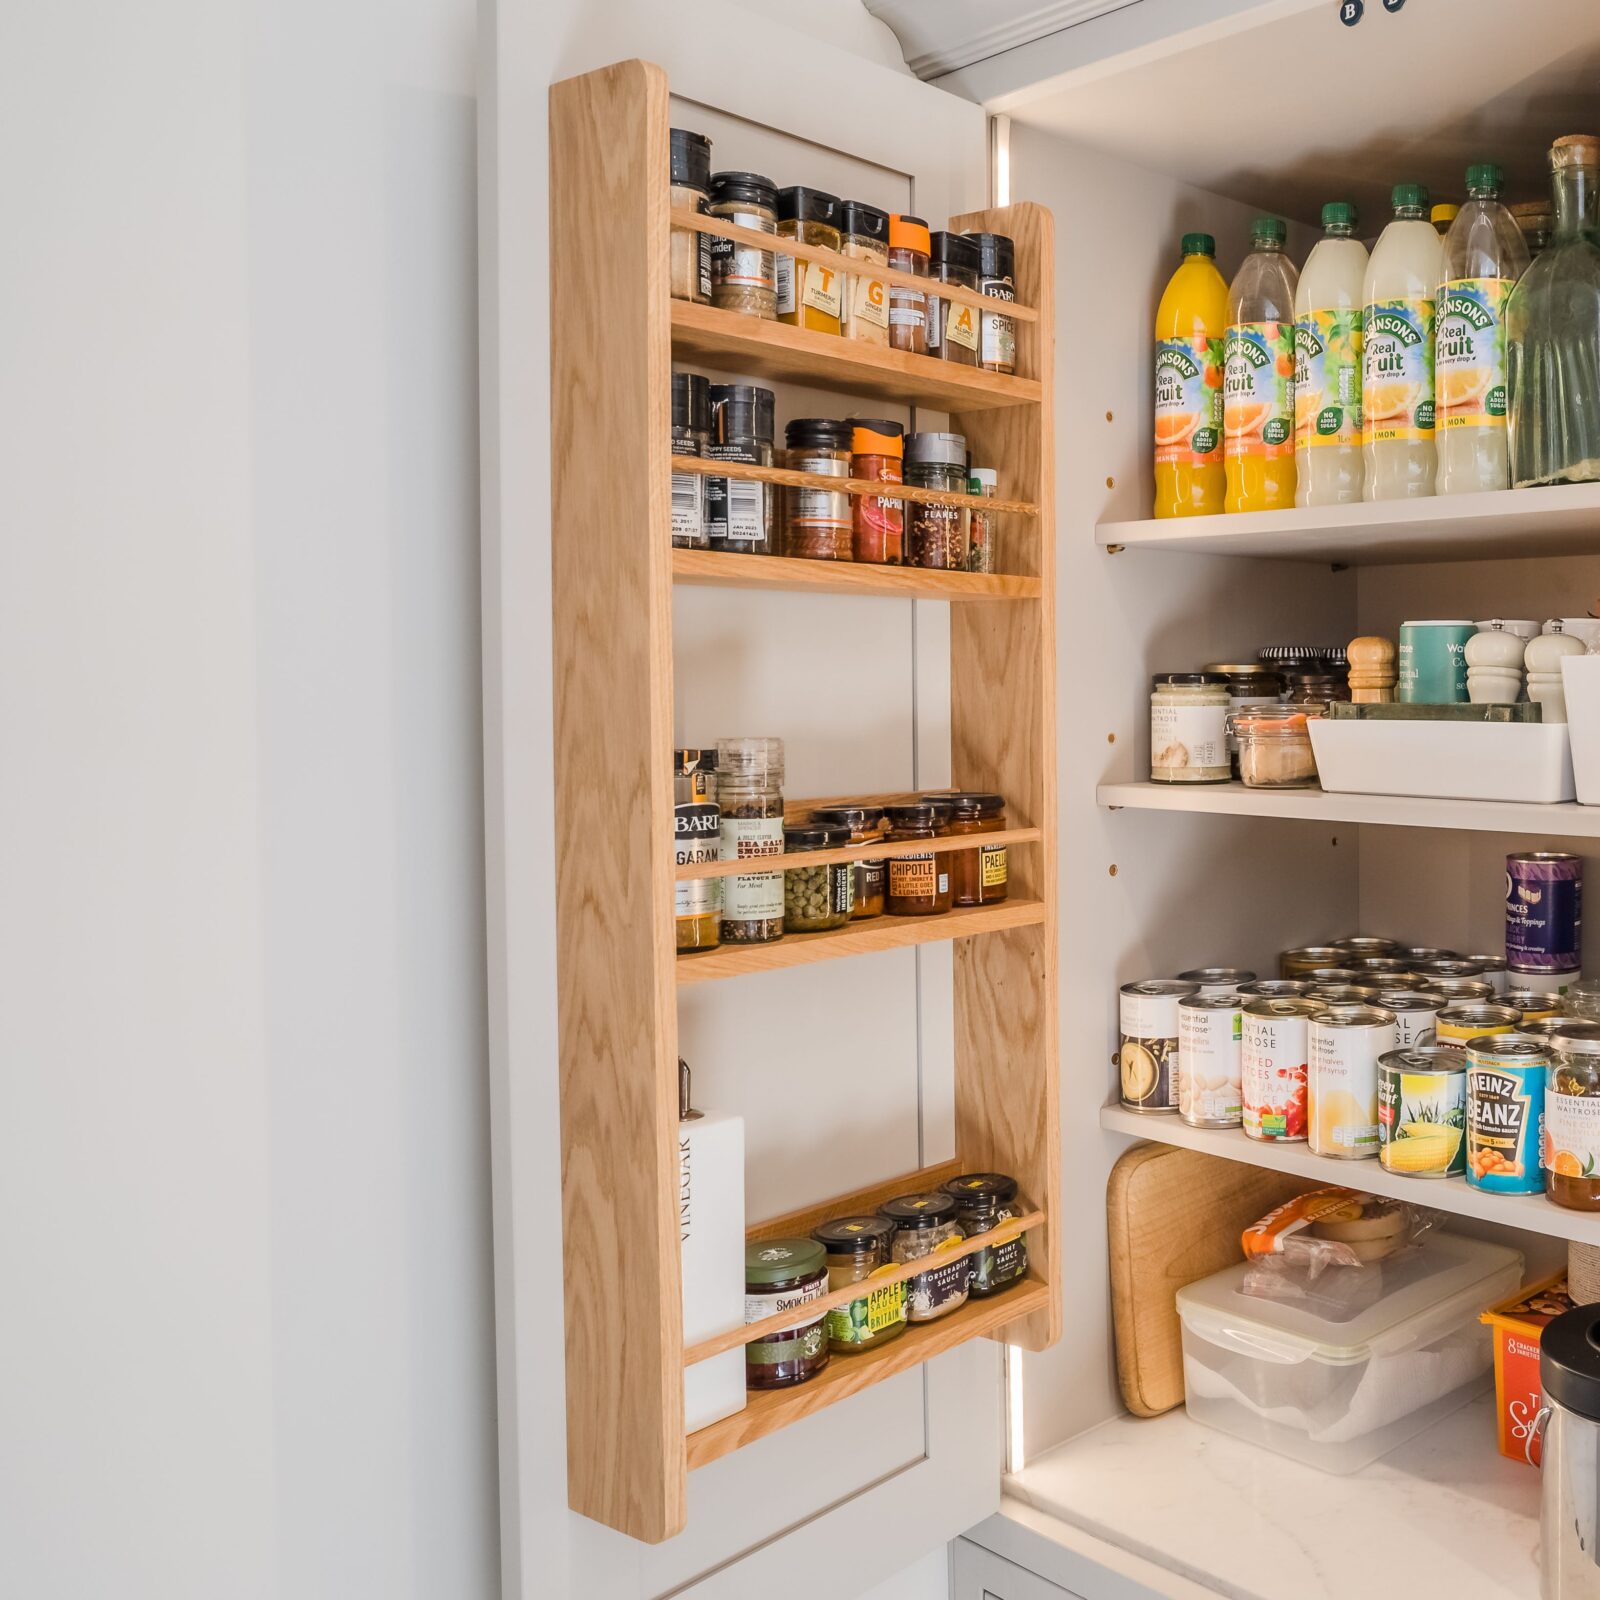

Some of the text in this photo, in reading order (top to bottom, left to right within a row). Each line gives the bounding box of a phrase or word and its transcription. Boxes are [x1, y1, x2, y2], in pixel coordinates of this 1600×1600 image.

[819, 266, 834, 293] T
[869, 281, 884, 305] G
[958, 307, 973, 332] A
[992, 320, 1014, 334] SPICE
[925, 511, 958, 520] FLAKES
[737, 847, 779, 855] SMOKED
[866, 871, 880, 882] RED
[891, 863, 933, 876] CHIPOTLE
[1470, 1074, 1513, 1097] HEINZ
[1468, 1097, 1520, 1126] BEANZ
[996, 1250, 1018, 1265] SAUCE
[998, 1243, 1015, 1257] MINT
[937, 1272, 959, 1287] SAUCE
[871, 1282, 899, 1305] APPLE
[870, 1308, 899, 1329] BRITAIN
[1508, 1338, 1516, 1354] 8
